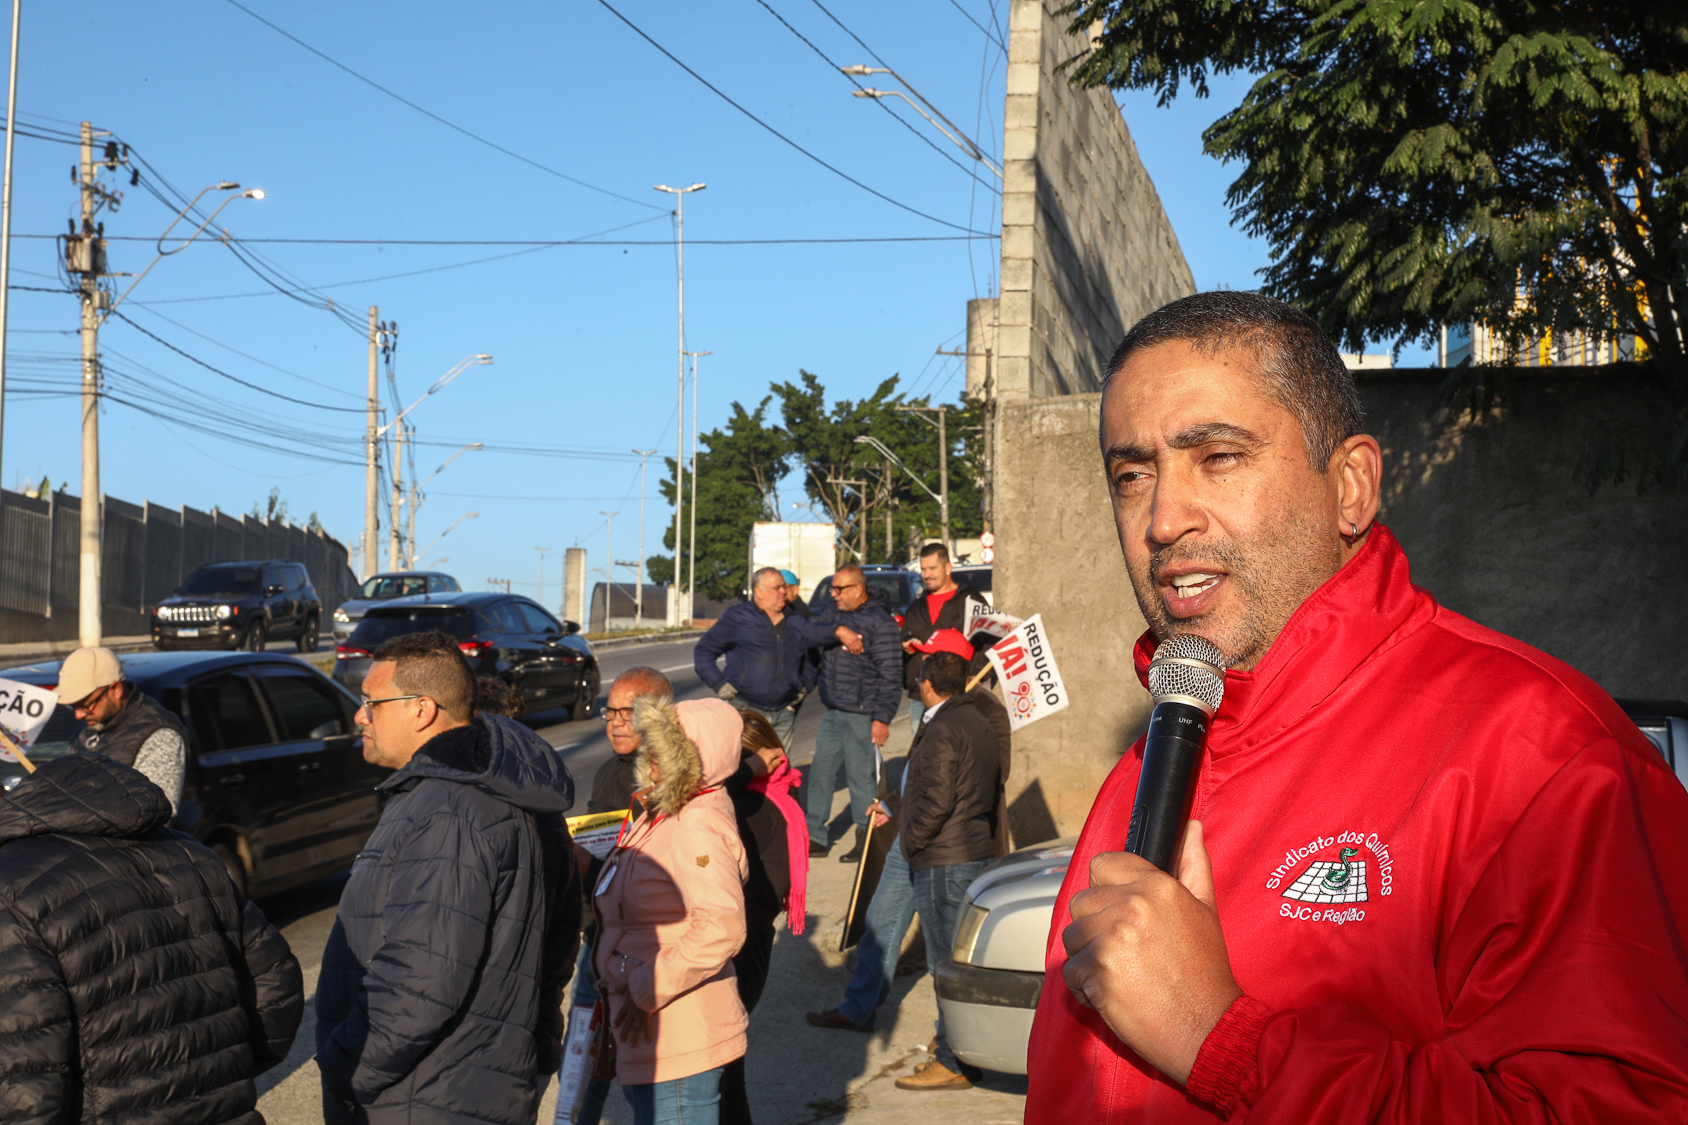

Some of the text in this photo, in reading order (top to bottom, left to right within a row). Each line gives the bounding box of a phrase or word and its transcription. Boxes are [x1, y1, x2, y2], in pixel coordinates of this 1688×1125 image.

[1023, 622, 1060, 706] REDUÇÃO
[1178, 716, 1193, 725] UHF
[1266, 830, 1394, 896] Sindicato dos Químicos
[1279, 903, 1365, 925] SJC e Região
